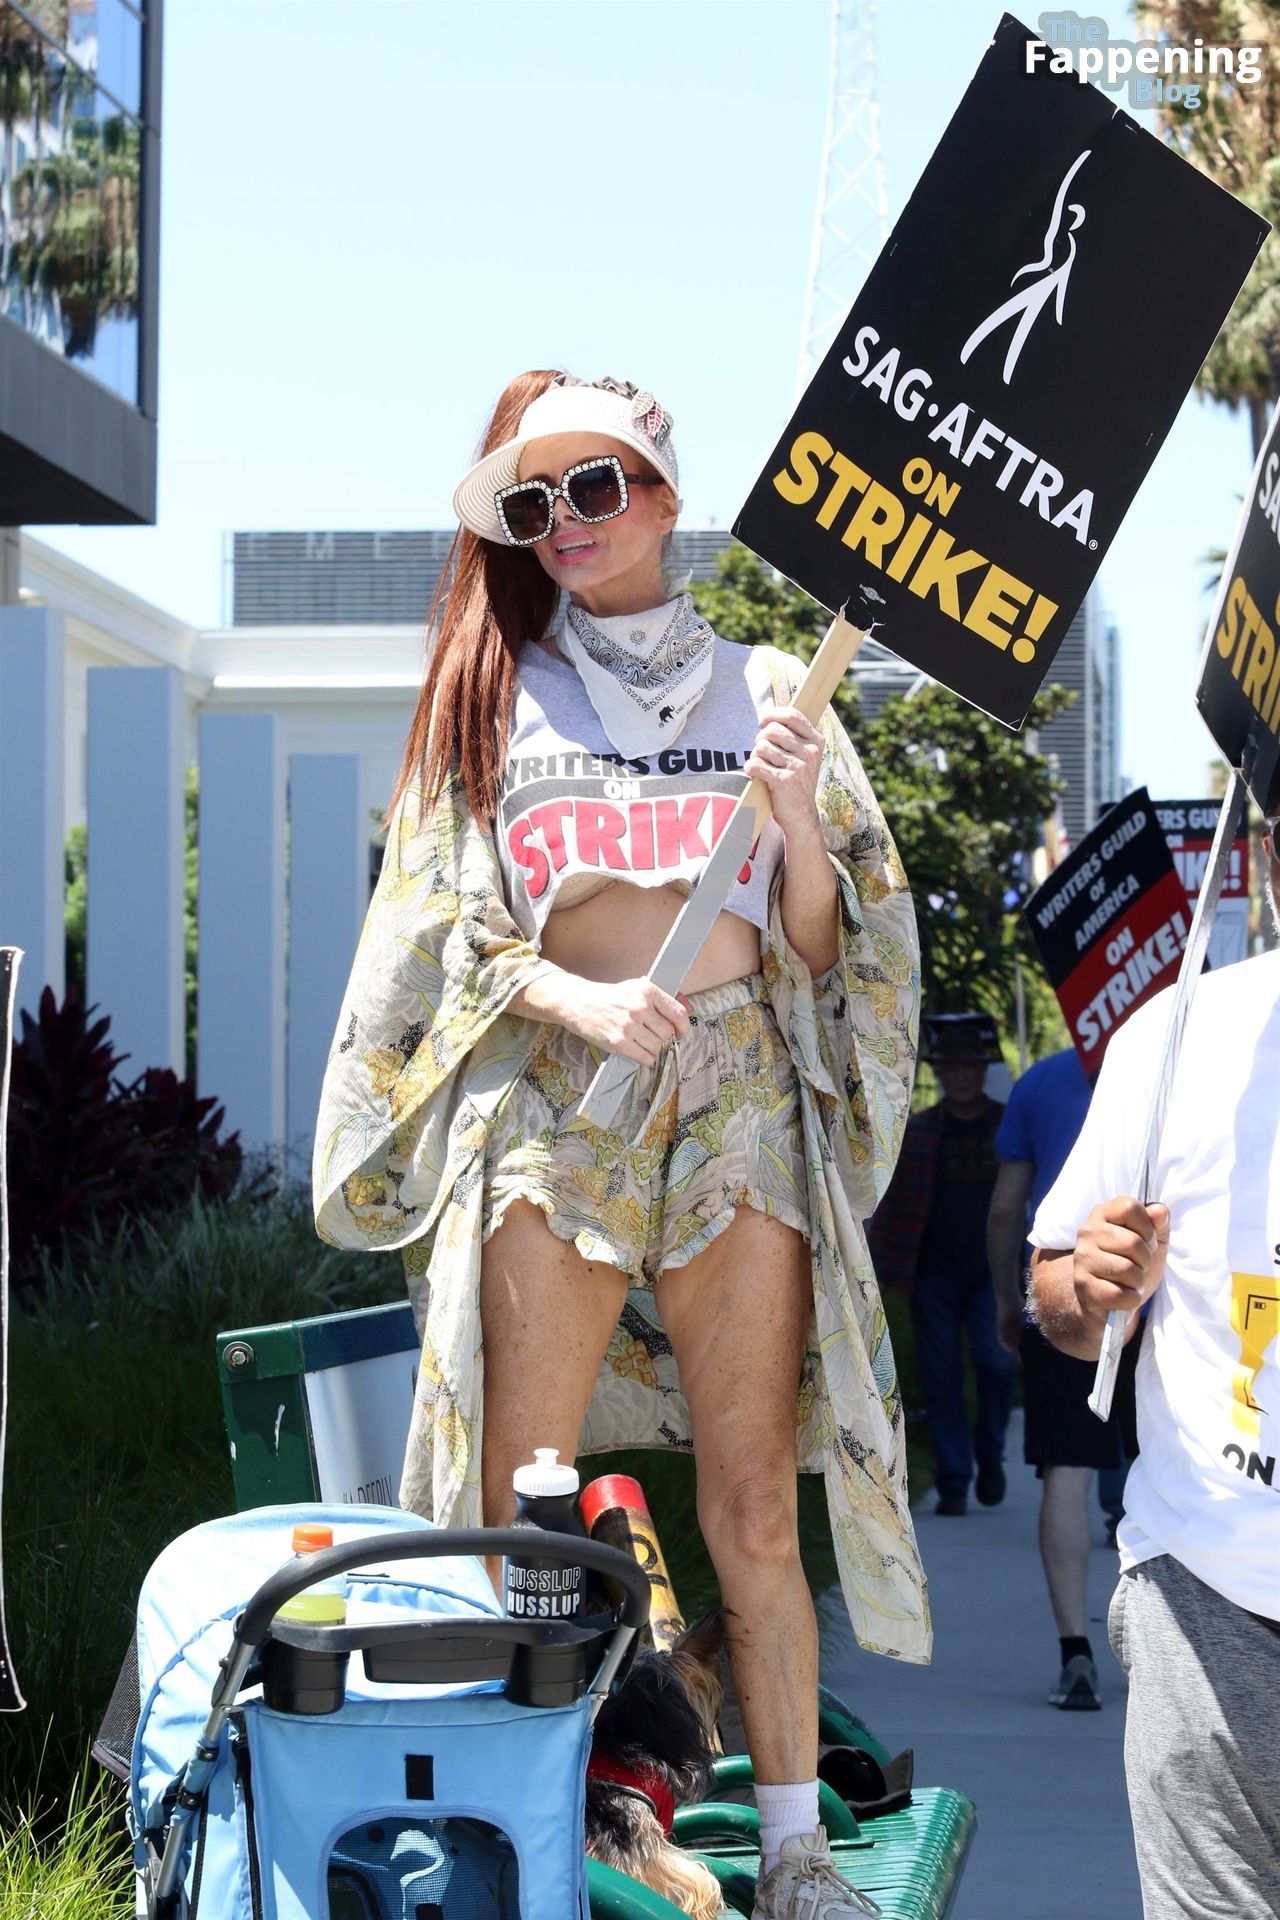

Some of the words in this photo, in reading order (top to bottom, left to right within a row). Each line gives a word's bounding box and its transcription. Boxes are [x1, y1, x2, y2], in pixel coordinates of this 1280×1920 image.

[902, 457, 961, 517] ON
[773, 431, 1059, 663] STRIKE!
[658, 749, 751, 775] GUIL
[603, 781, 641, 800] ON
[1037, 849, 1103, 929] WRITERS
[1100, 811, 1147, 860] GUILD
[1089, 878, 1106, 901] OF
[1074, 874, 1140, 950] AMERICA
[1106, 926, 1135, 966] ON
[1076, 911, 1189, 1052] STRIKE!
[508, 1564, 580, 1592] HUSSLUP
[507, 1590, 580, 1617] HUSSLUP
